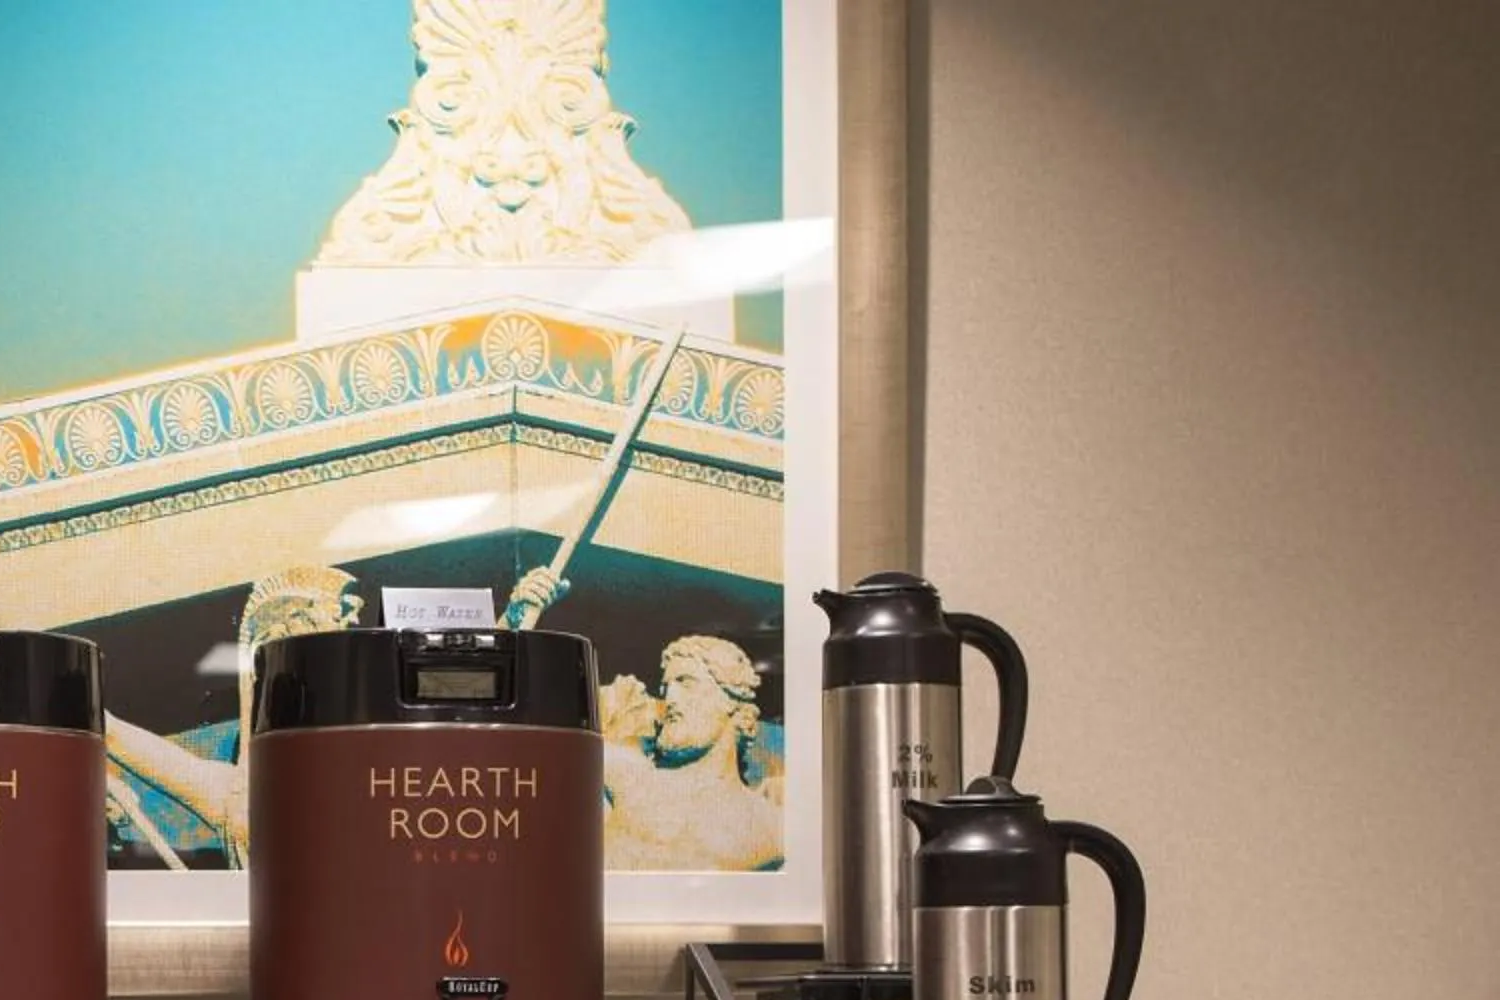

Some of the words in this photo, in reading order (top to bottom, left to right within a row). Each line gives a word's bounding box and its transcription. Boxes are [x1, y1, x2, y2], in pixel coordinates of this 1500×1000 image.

[897, 743, 933, 764] 2%
[370, 767, 538, 798] HEARTH
[891, 770, 939, 789] Milk
[390, 807, 520, 840] ROOM
[969, 975, 1035, 995] Skim
